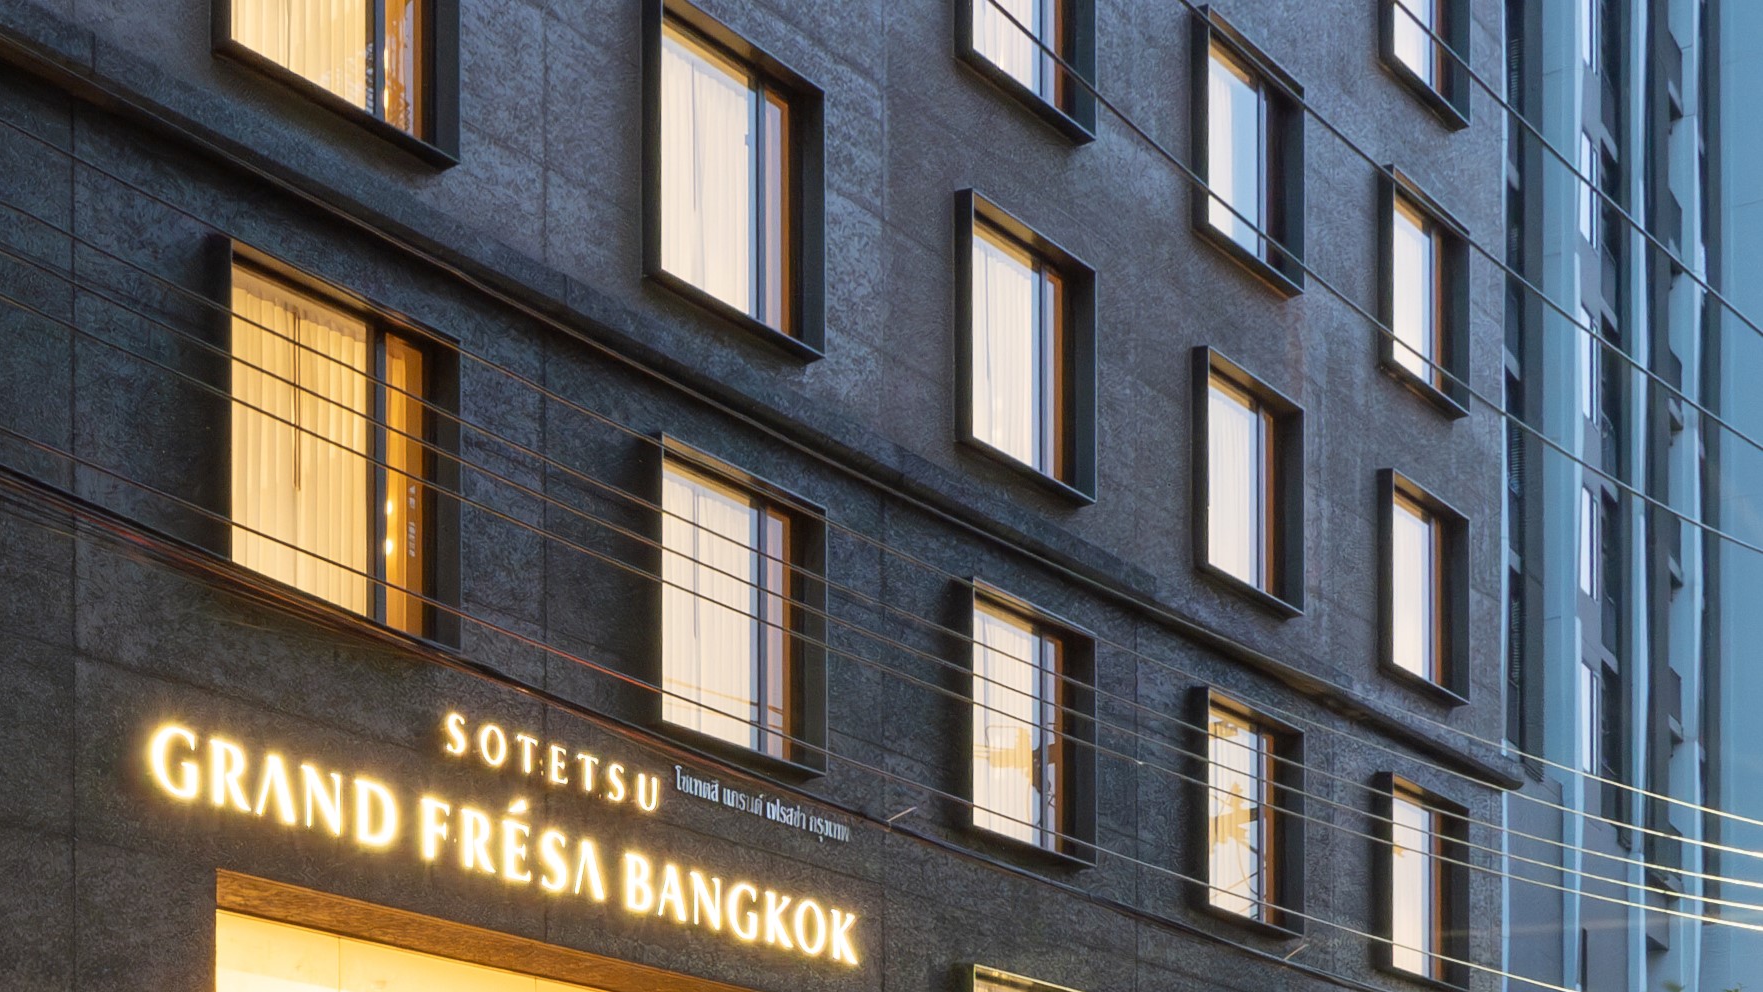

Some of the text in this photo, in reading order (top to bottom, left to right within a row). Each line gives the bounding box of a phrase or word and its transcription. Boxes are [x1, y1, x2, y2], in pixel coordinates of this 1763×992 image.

[148, 723, 860, 967] GRAND FRÉSA BANGKOK
[444, 712, 659, 813] SOTETSU
